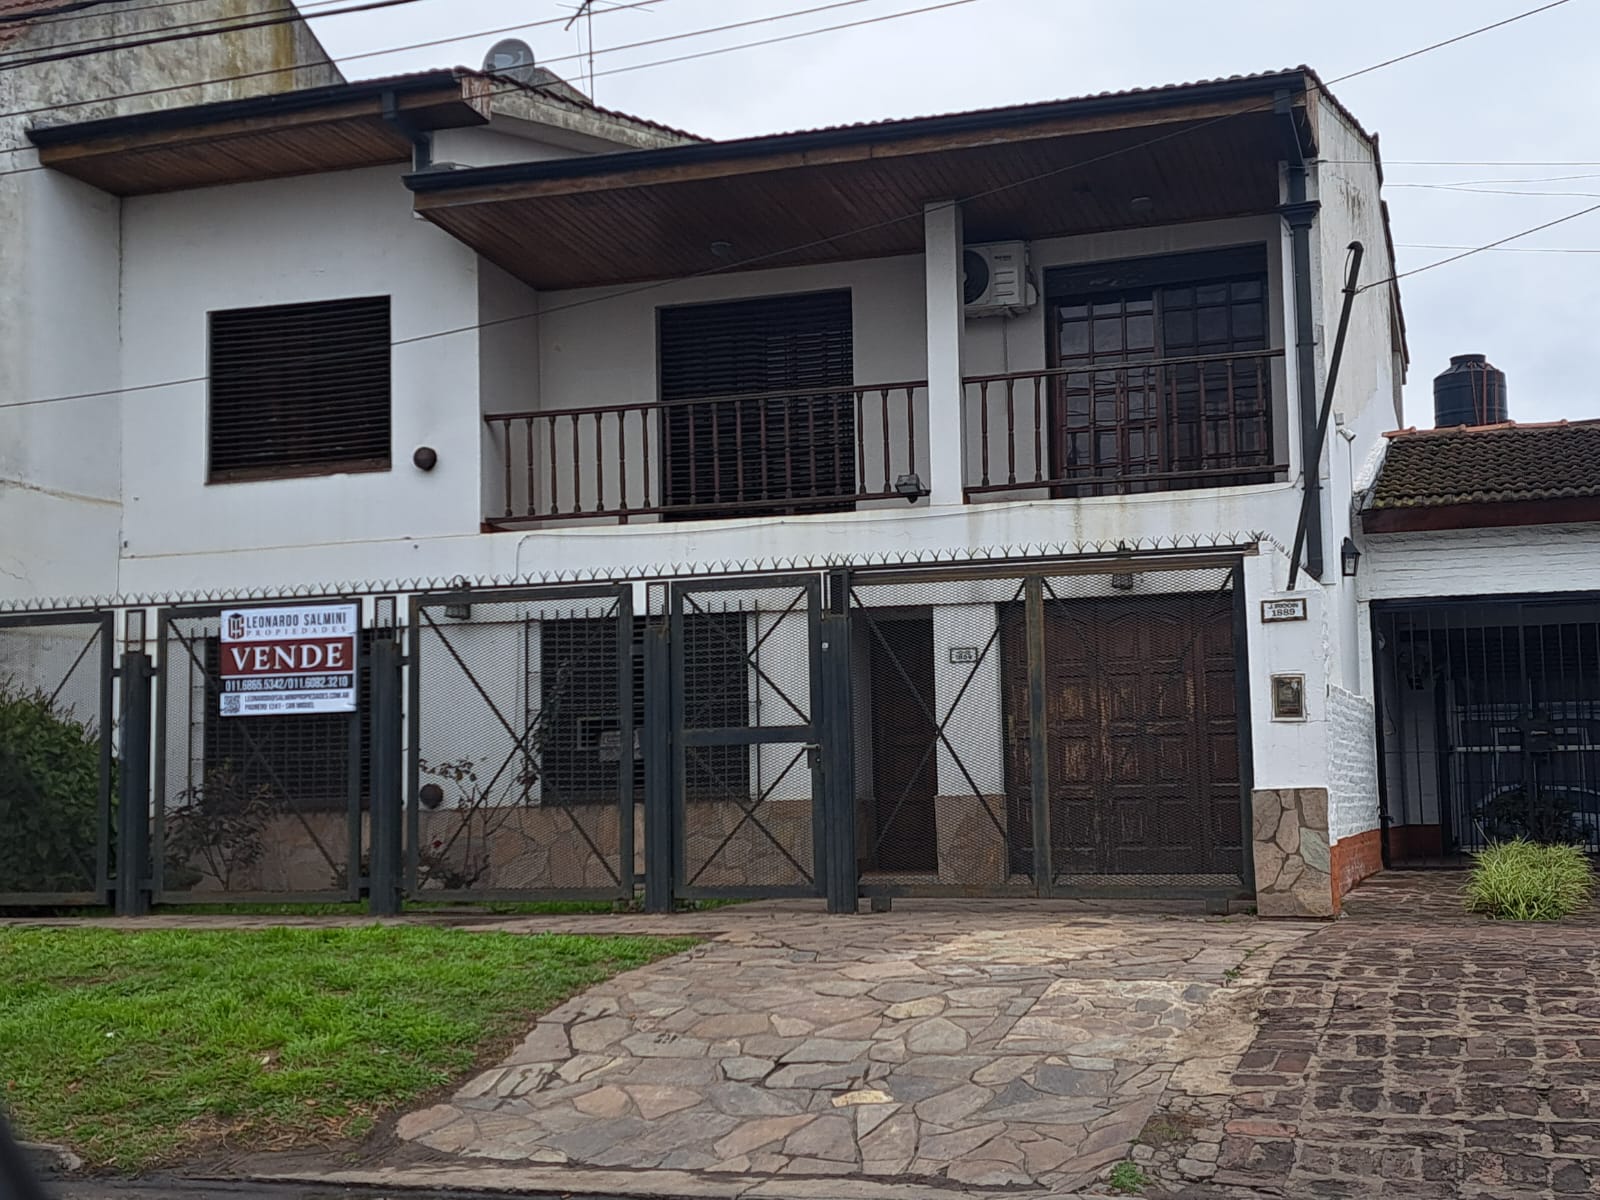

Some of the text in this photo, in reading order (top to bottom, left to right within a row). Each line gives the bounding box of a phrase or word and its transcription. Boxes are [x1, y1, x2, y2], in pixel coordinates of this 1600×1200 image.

[246, 611, 347, 629] LEONARDO SALMINI
[246, 626, 347, 637] PROPIEDADES
[230, 642, 344, 671] VENDE
